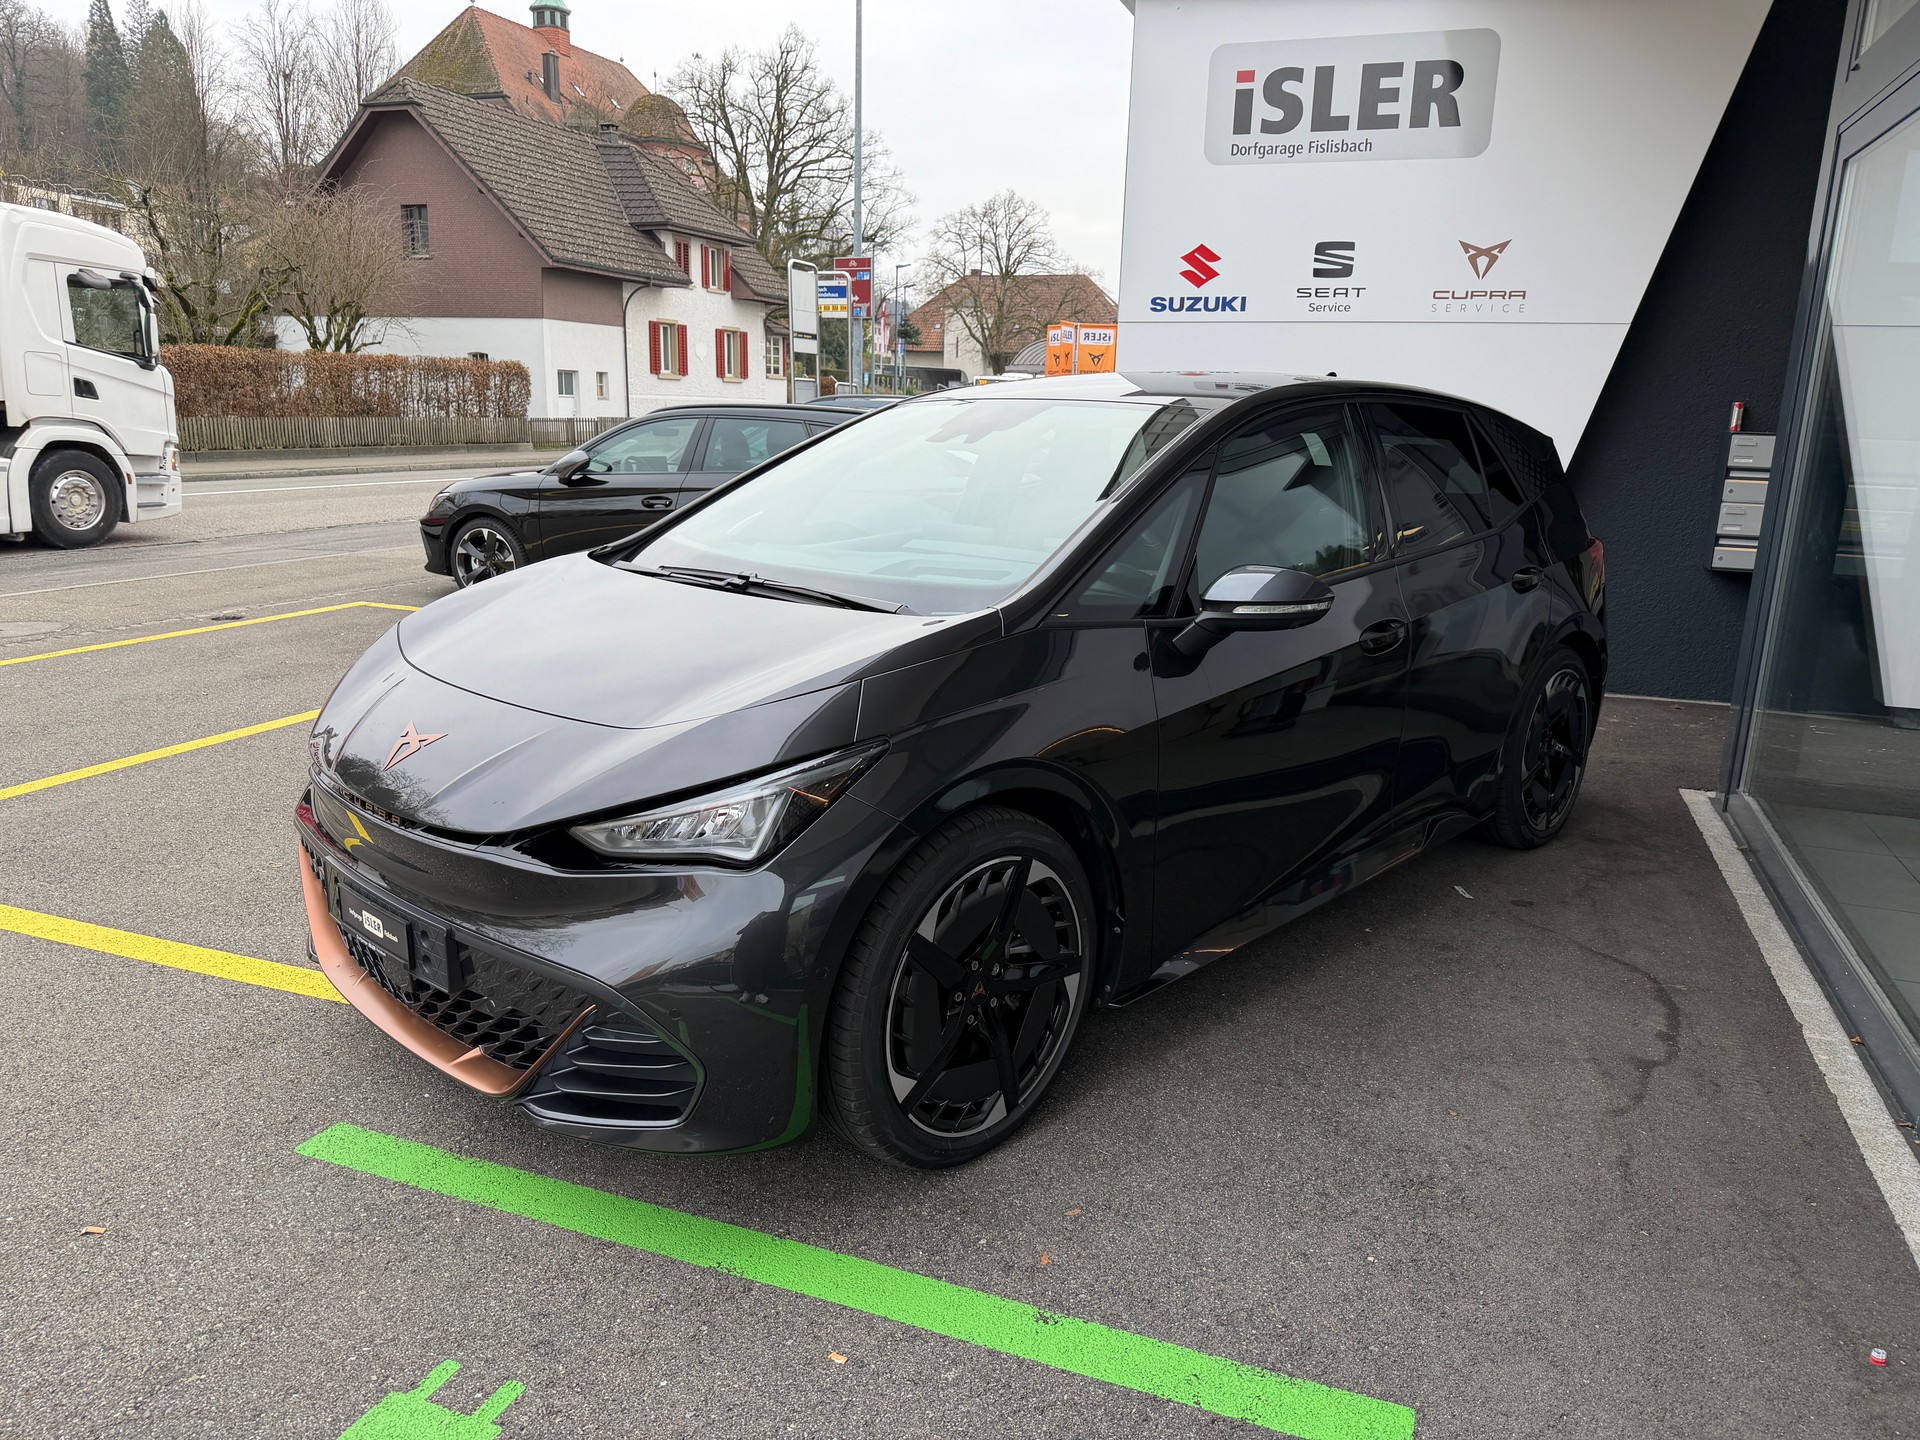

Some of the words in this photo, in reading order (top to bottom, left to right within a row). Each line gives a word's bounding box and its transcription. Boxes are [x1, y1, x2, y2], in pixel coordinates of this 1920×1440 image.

[1232, 59, 1465, 136] iSLER
[1230, 143, 1304, 159] Dorfgarage
[1307, 138, 1373, 154] Fislisbach
[1296, 287, 1366, 299] SEAT
[1432, 290, 1527, 301] CUPRA
[1150, 296, 1247, 313] SUZUKI
[1308, 303, 1351, 313] Service
[1431, 303, 1526, 314] SERVICE
[364, 914, 382, 934] iSLER
